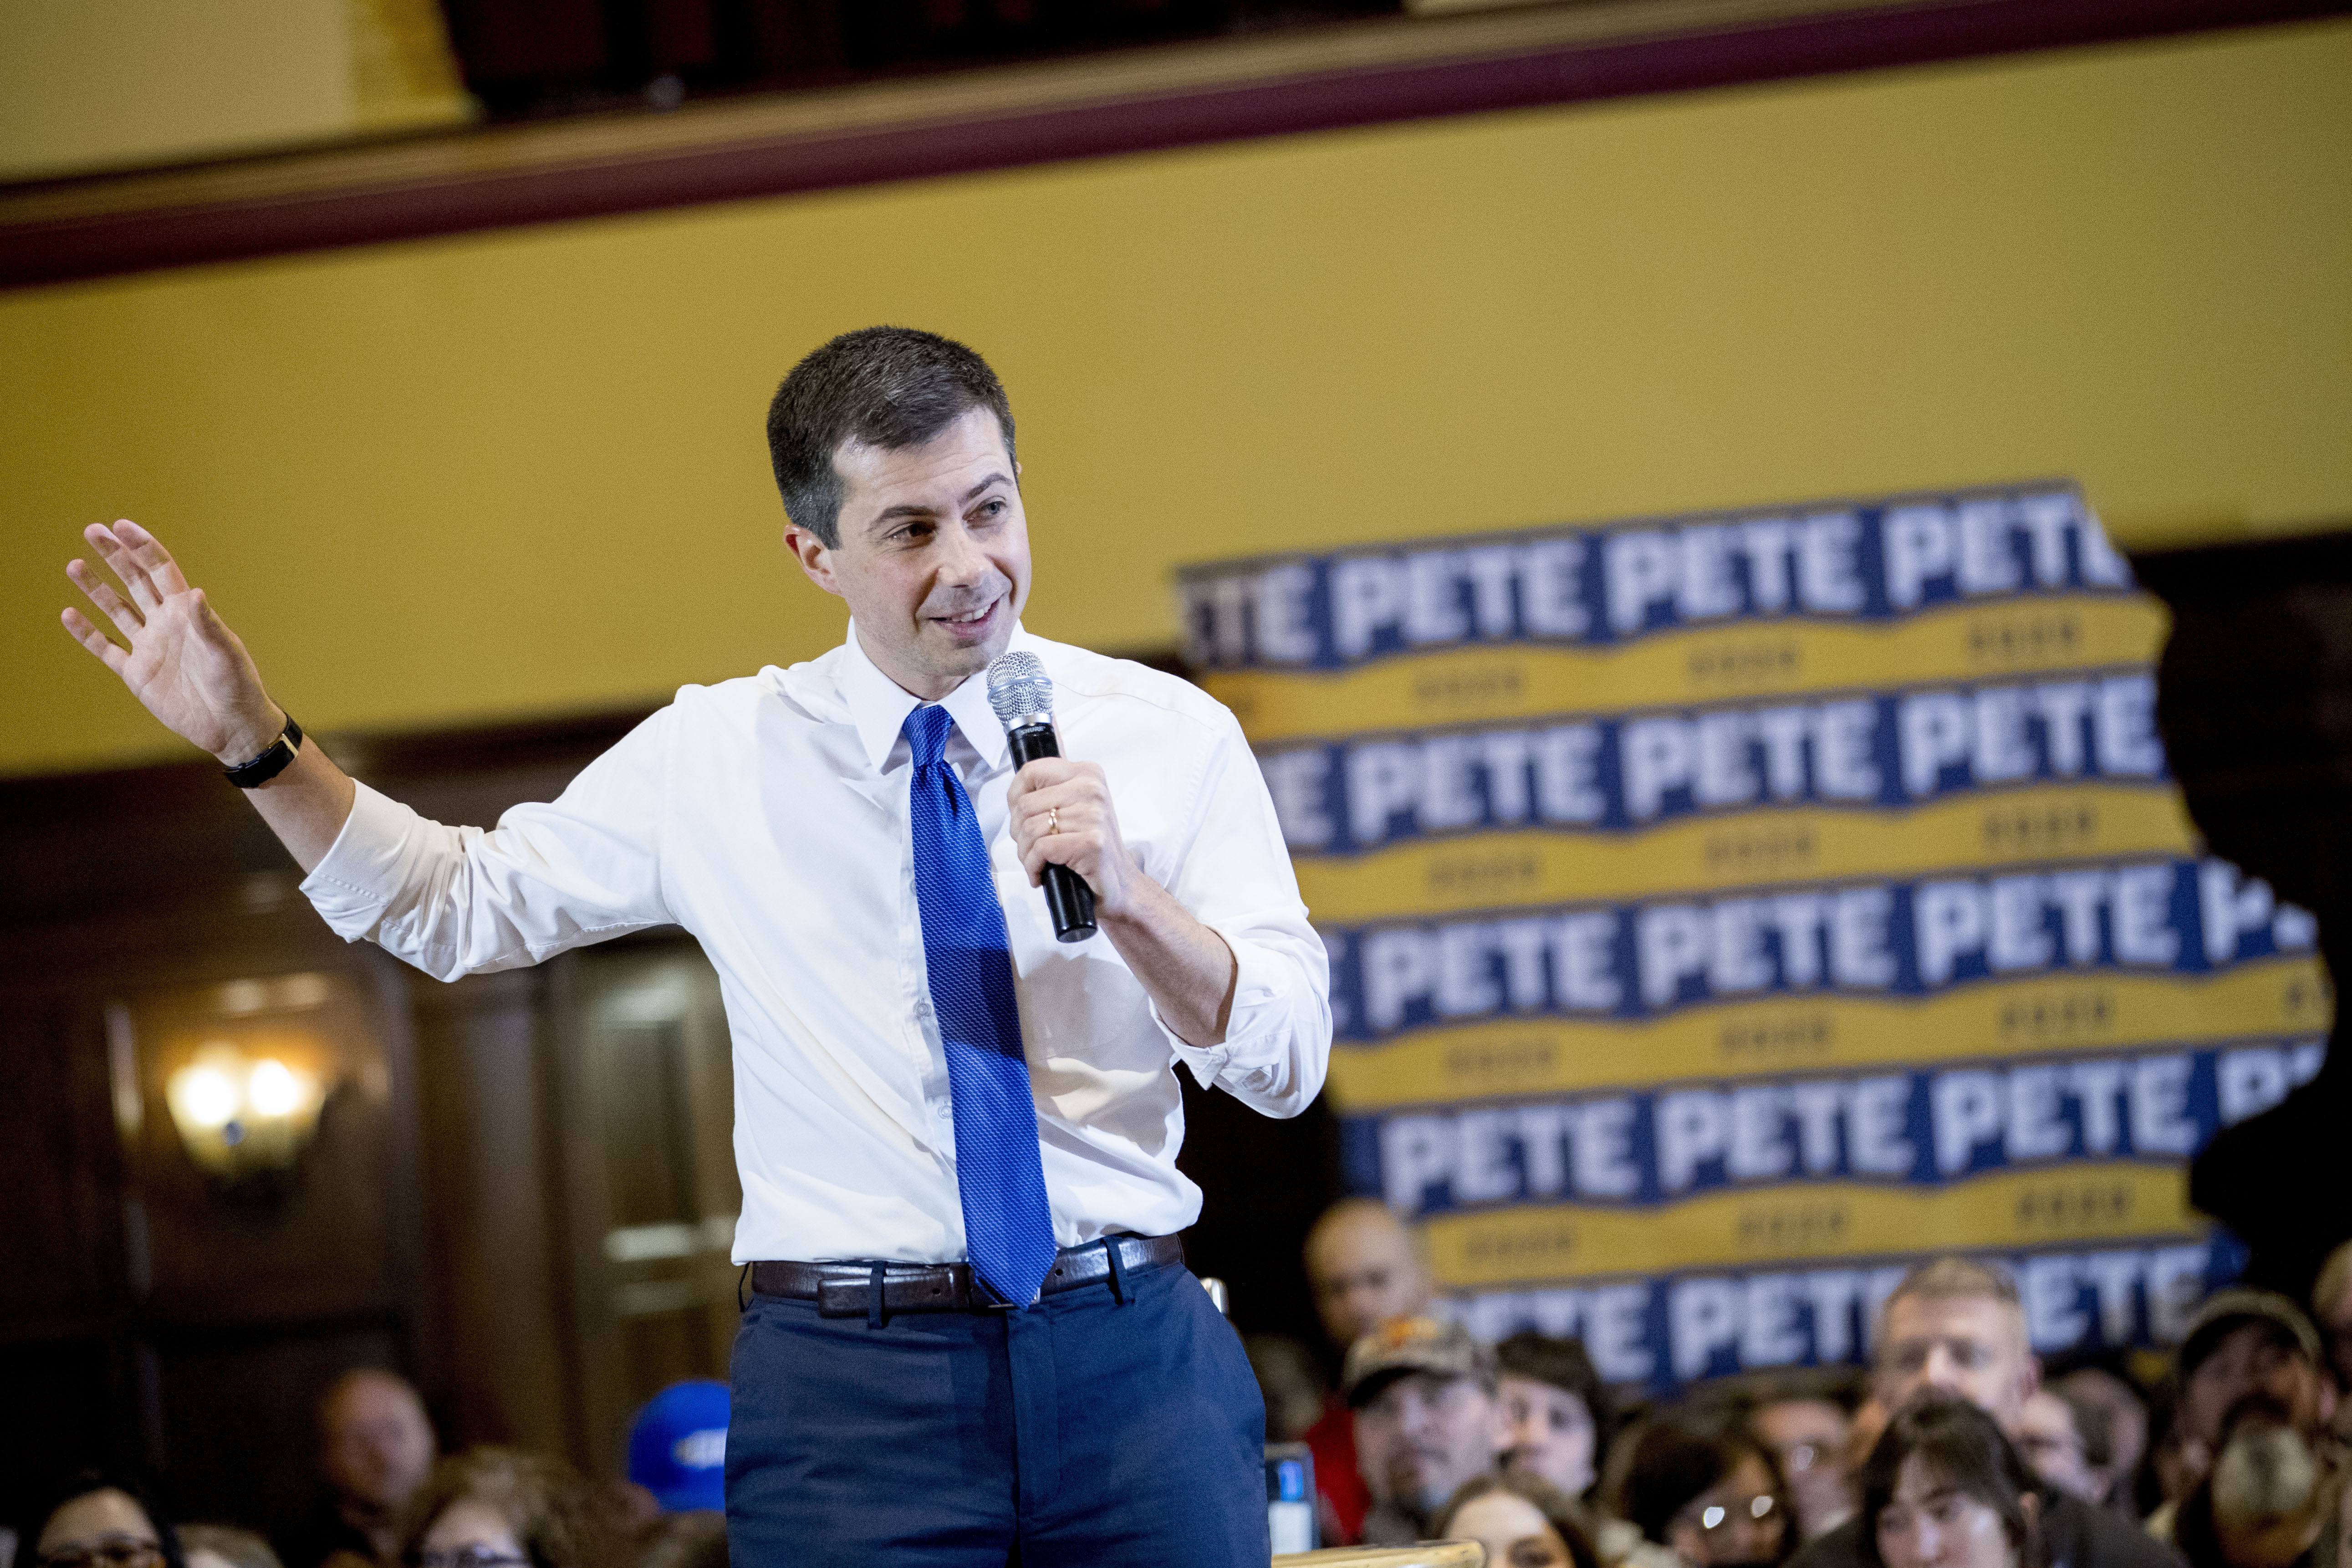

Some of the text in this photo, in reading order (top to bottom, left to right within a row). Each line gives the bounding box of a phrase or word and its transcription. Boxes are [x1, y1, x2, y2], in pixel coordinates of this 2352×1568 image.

[1331, 538, 1589, 658] PETE
[1605, 512, 1865, 632] PETE
[1020, 726, 1045, 735] SHURE
[1347, 728, 1604, 843] PETE
[1622, 699, 1882, 819] PETE
[1897, 676, 2159, 796] PETE
[1367, 912, 1622, 1028] PETE
[1639, 887, 1899, 1003] PETE
[1916, 864, 2180, 983] PETE
[1380, 1099, 1640, 1211] PETE
[1655, 1076, 1915, 1189] PETE
[1931, 1056, 2199, 1172] PETE
